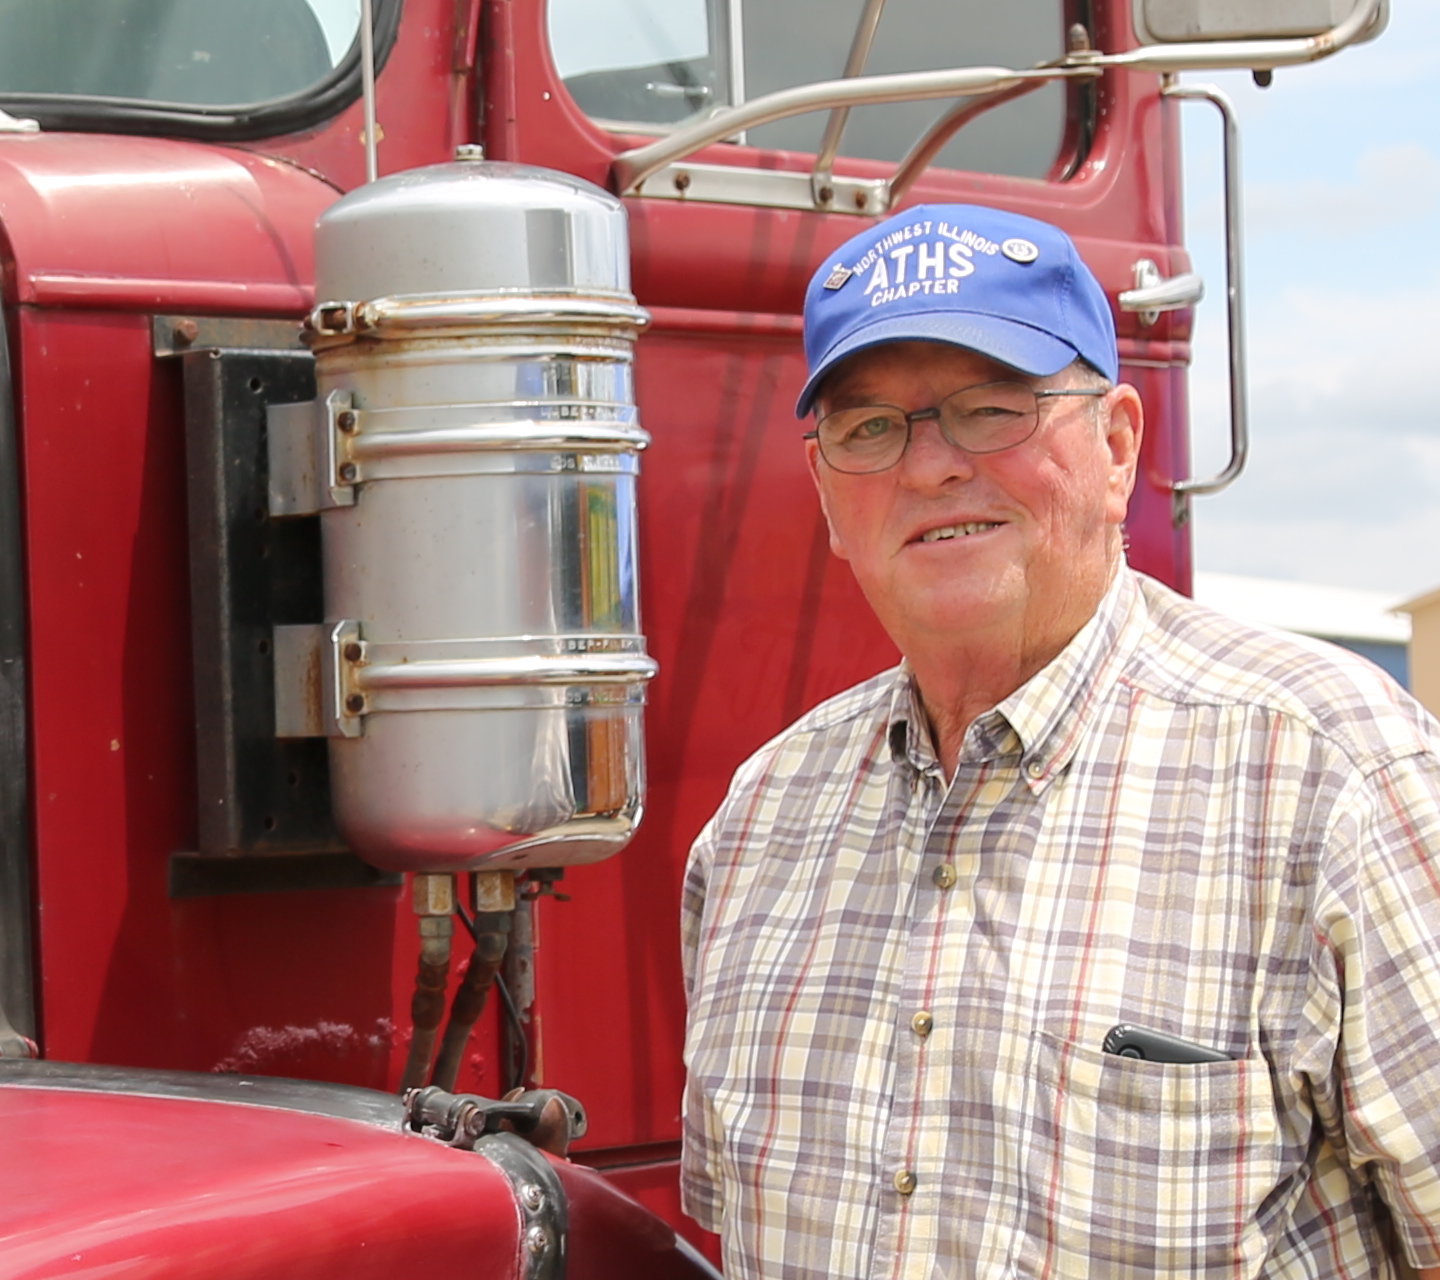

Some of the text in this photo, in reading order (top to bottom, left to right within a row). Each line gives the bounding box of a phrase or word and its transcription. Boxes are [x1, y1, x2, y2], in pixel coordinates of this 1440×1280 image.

[852, 221, 1001, 277] NORTHWEST ILLINOIS
[863, 241, 975, 295] ATHS
[871, 278, 959, 307] CHAPTER
